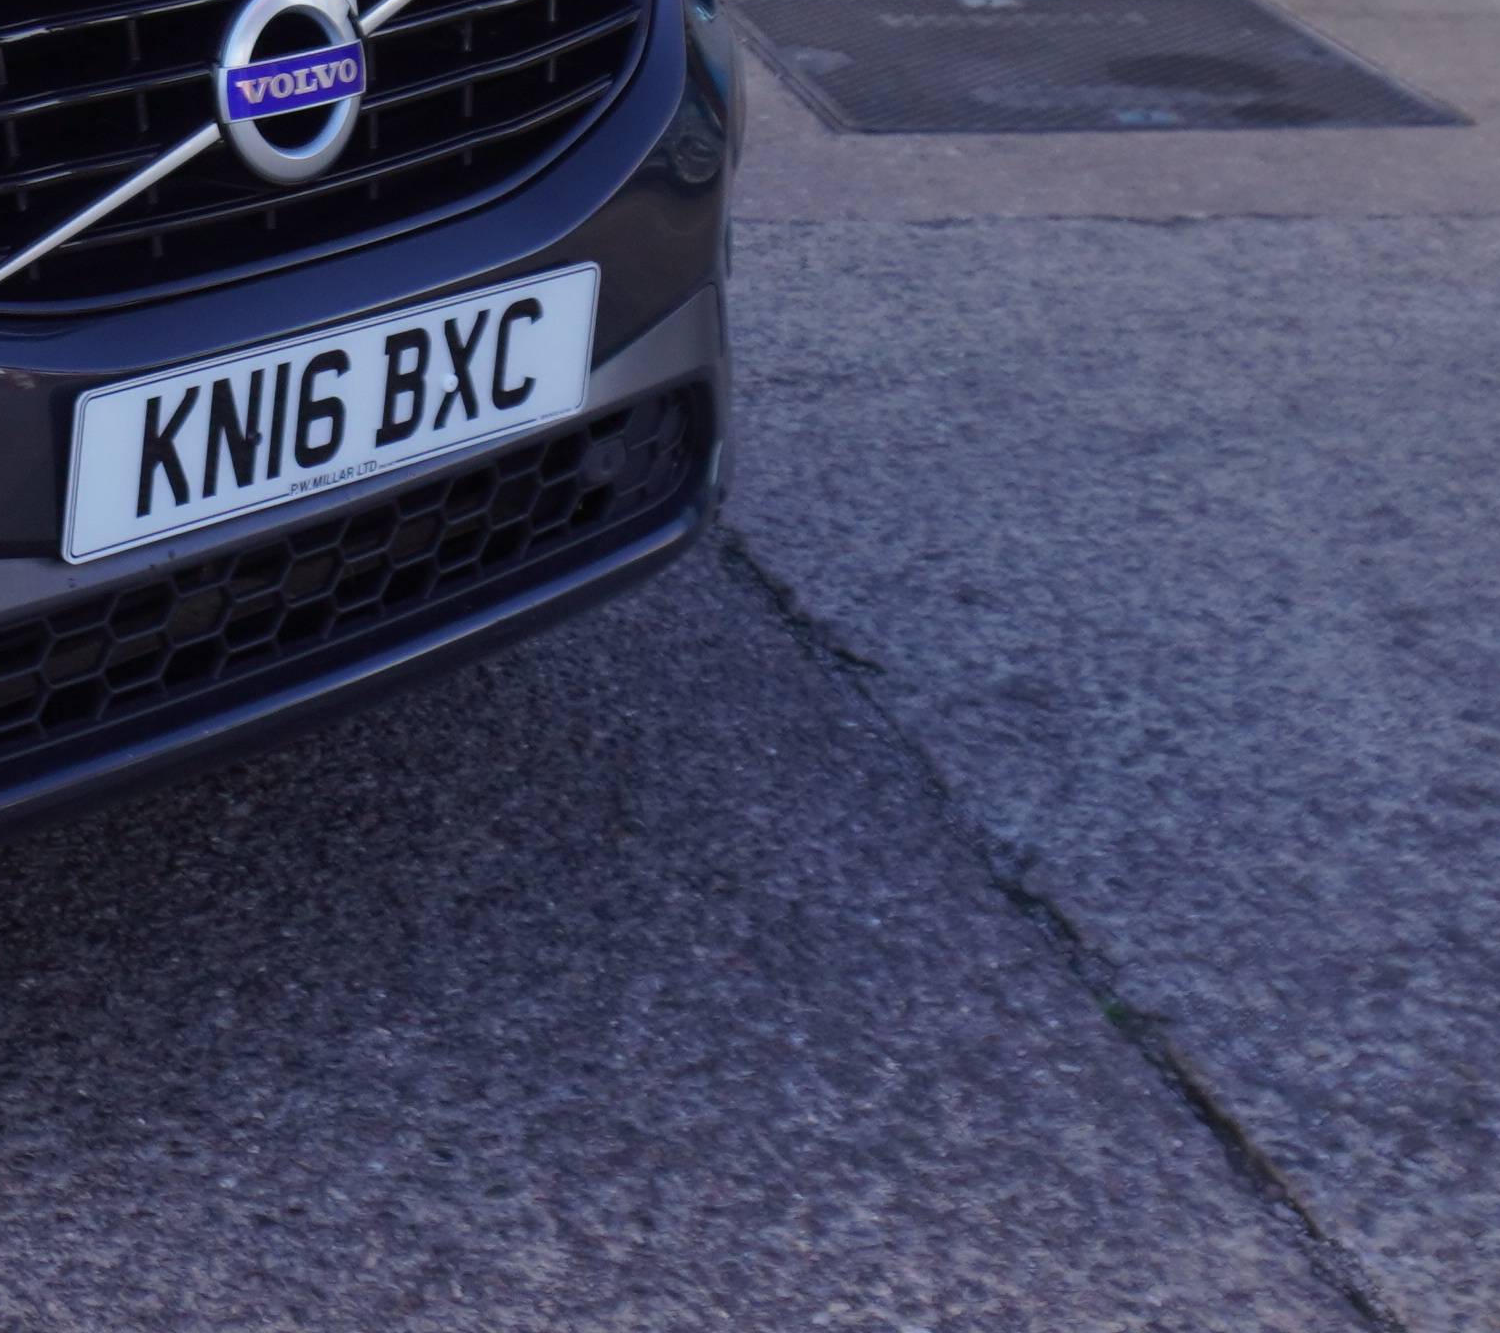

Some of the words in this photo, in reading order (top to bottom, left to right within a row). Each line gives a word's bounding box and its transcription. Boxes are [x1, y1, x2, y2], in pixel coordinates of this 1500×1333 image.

[235, 58, 358, 105] VOLVO
[136, 349, 352, 519] KN16
[375, 296, 544, 448] BXC
[357, 459, 378, 476] LTD
